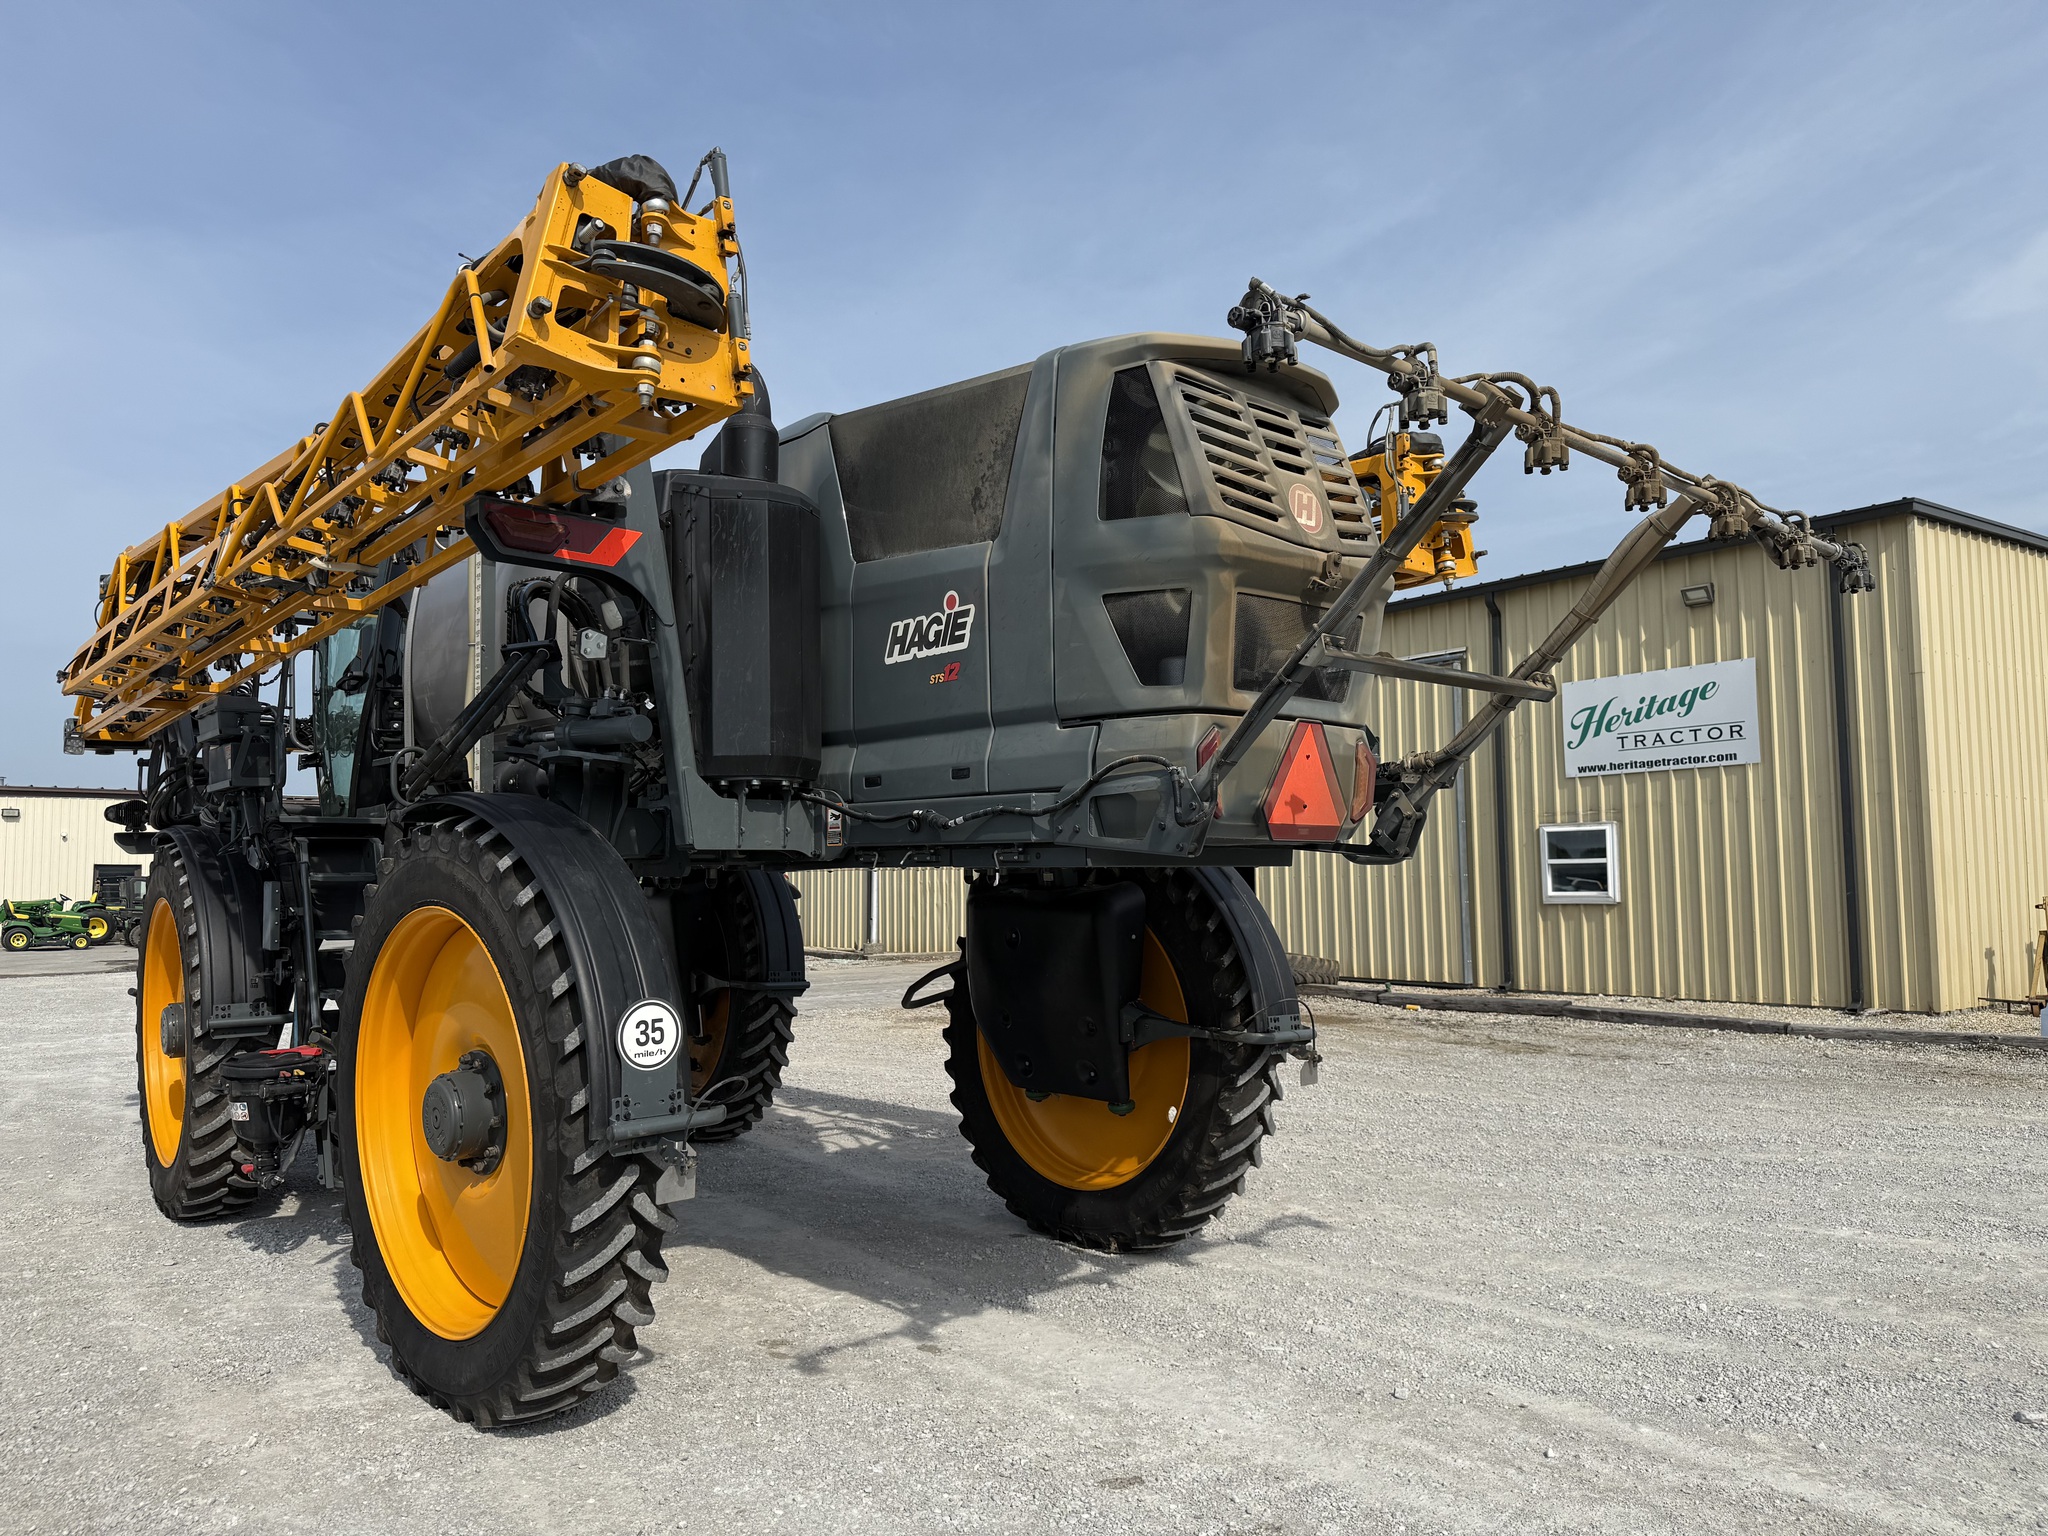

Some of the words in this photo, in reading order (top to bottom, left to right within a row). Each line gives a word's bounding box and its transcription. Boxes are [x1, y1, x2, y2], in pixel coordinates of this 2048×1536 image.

[1567, 681, 1720, 749] Heritage
[1617, 724, 1744, 749] TRACTOR
[1578, 752, 1737, 774] www.heritagetractor.com
[635, 1018, 665, 1046] 35
[634, 1048, 667, 1058] mile/h
